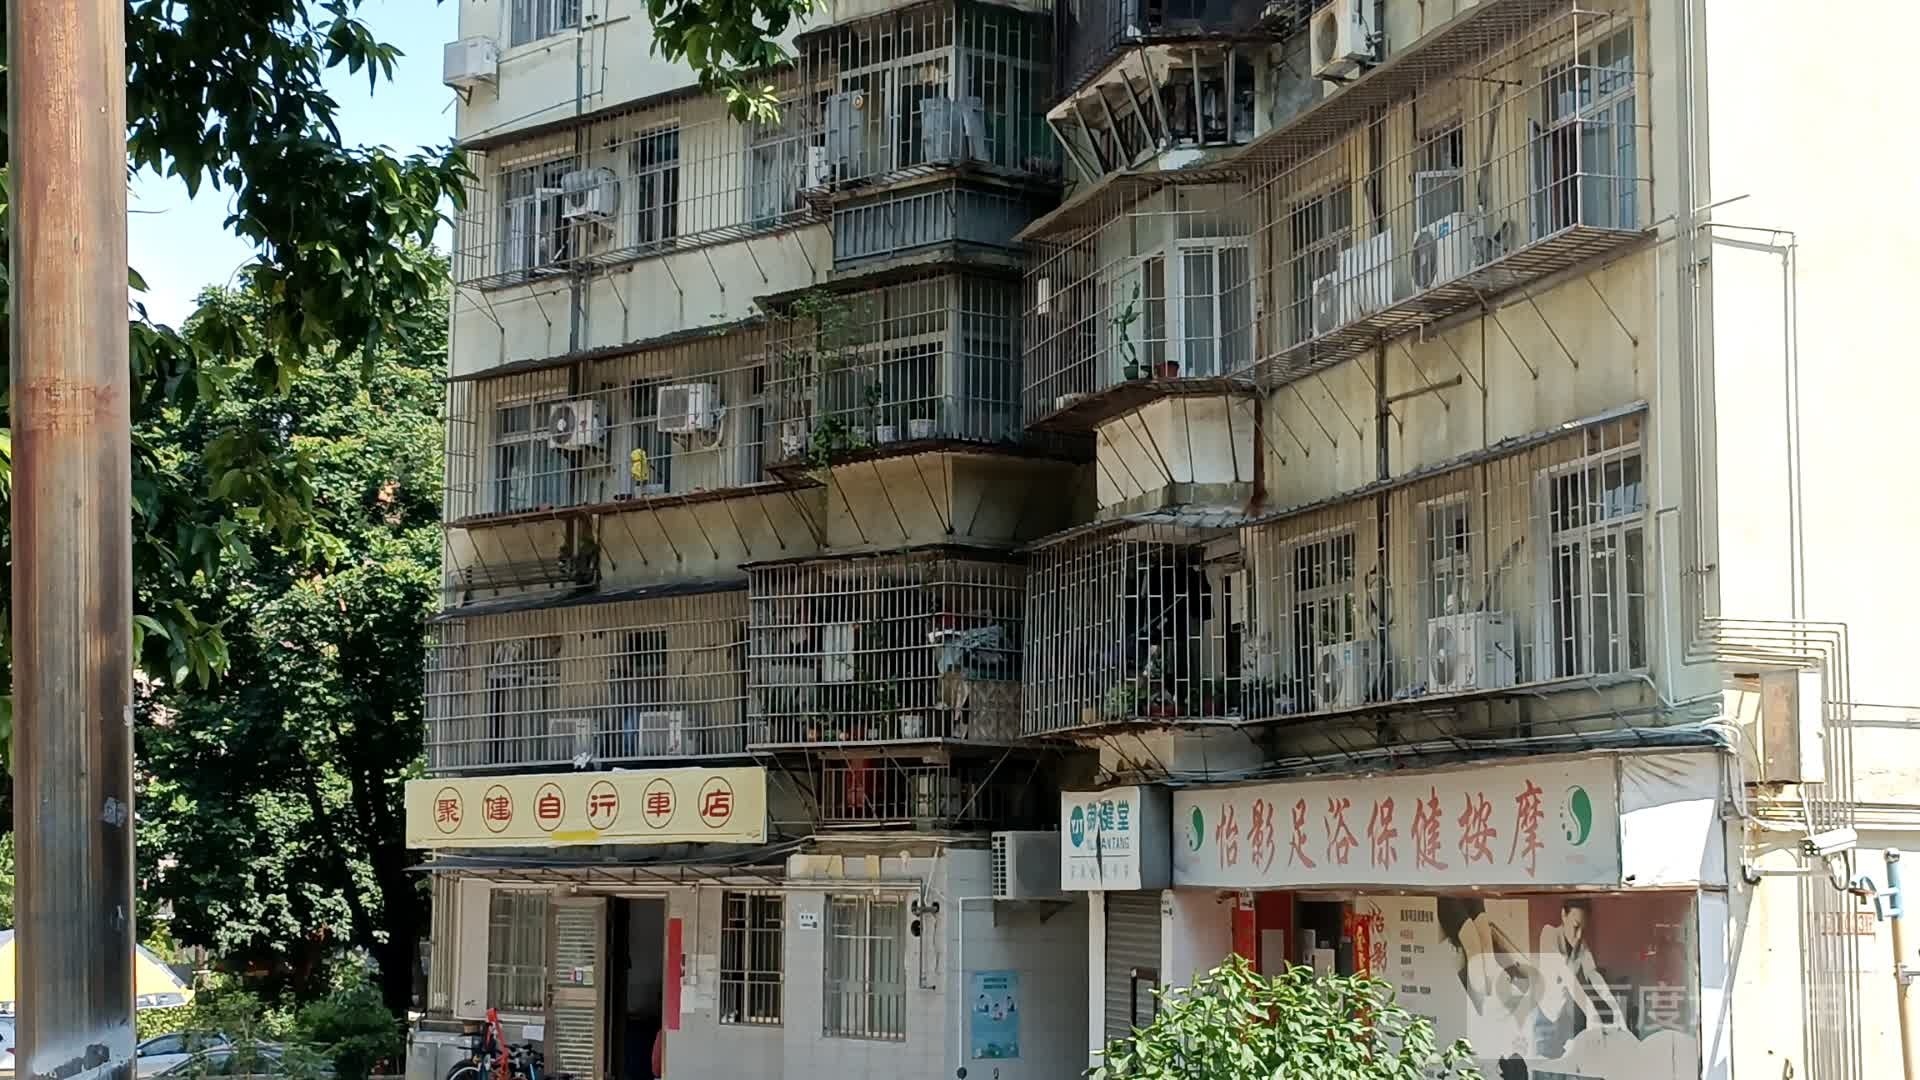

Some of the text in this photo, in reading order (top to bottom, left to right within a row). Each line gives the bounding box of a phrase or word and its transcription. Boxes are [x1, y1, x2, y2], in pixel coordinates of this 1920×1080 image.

[436, 788, 732, 824] 聚健自行車店
[1215, 779, 1545, 878] 怡影足浴保健按摩
